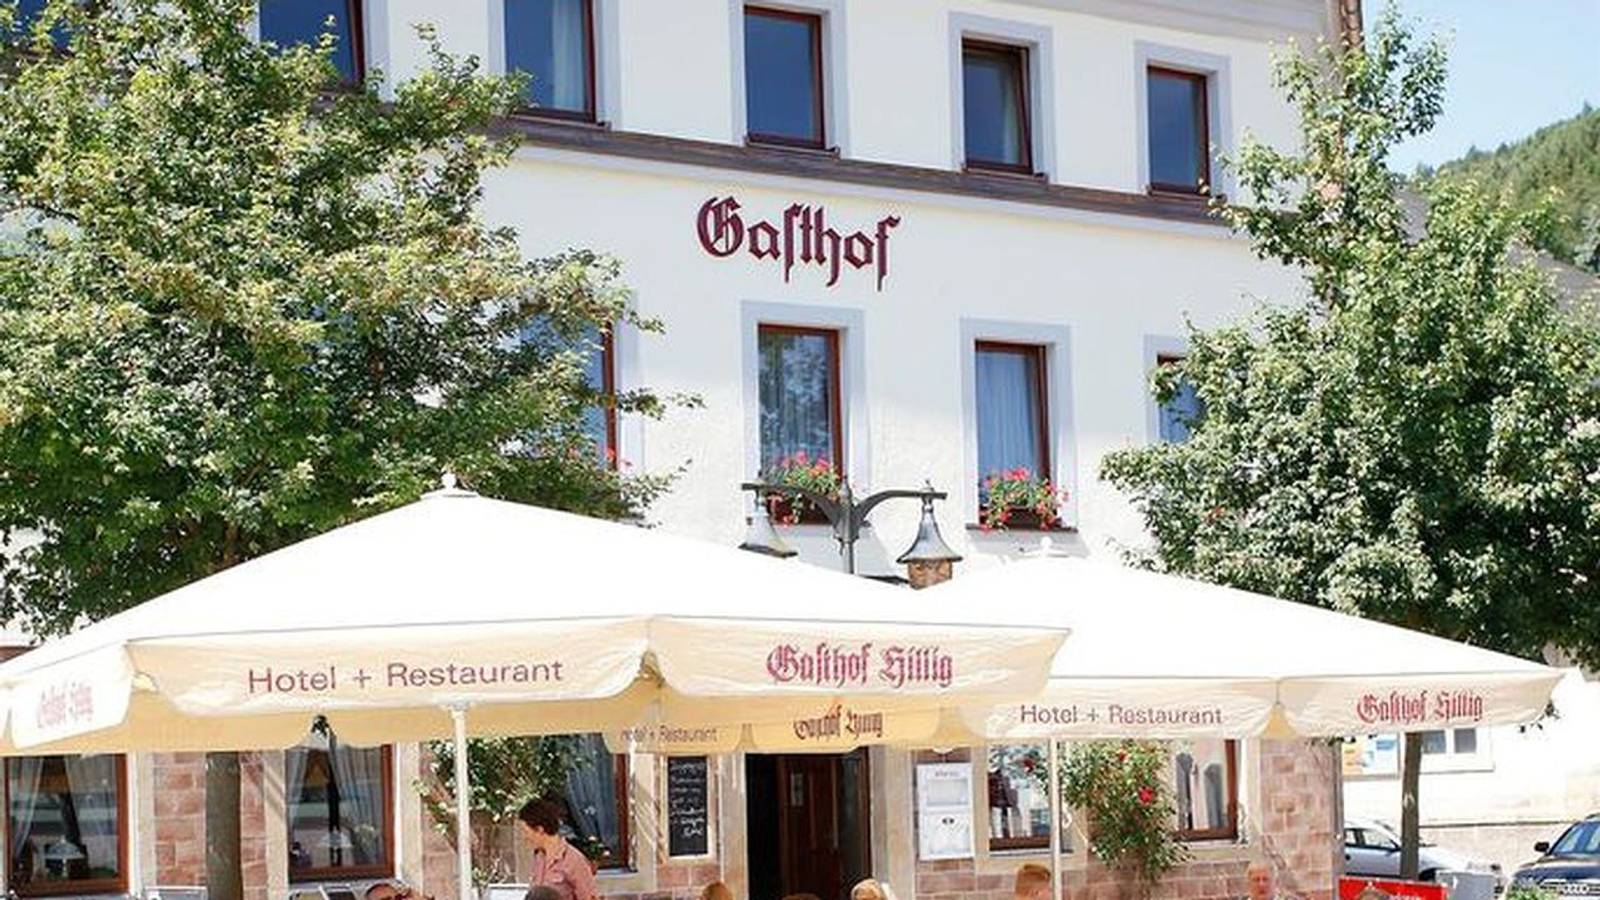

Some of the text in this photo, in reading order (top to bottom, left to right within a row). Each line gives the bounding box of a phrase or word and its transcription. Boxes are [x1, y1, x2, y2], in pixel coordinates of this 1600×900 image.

[248, 660, 563, 693] Hotel + Restaurant
[1020, 704, 1077, 724] Hotel
[1109, 705, 1223, 724] Restaurant
